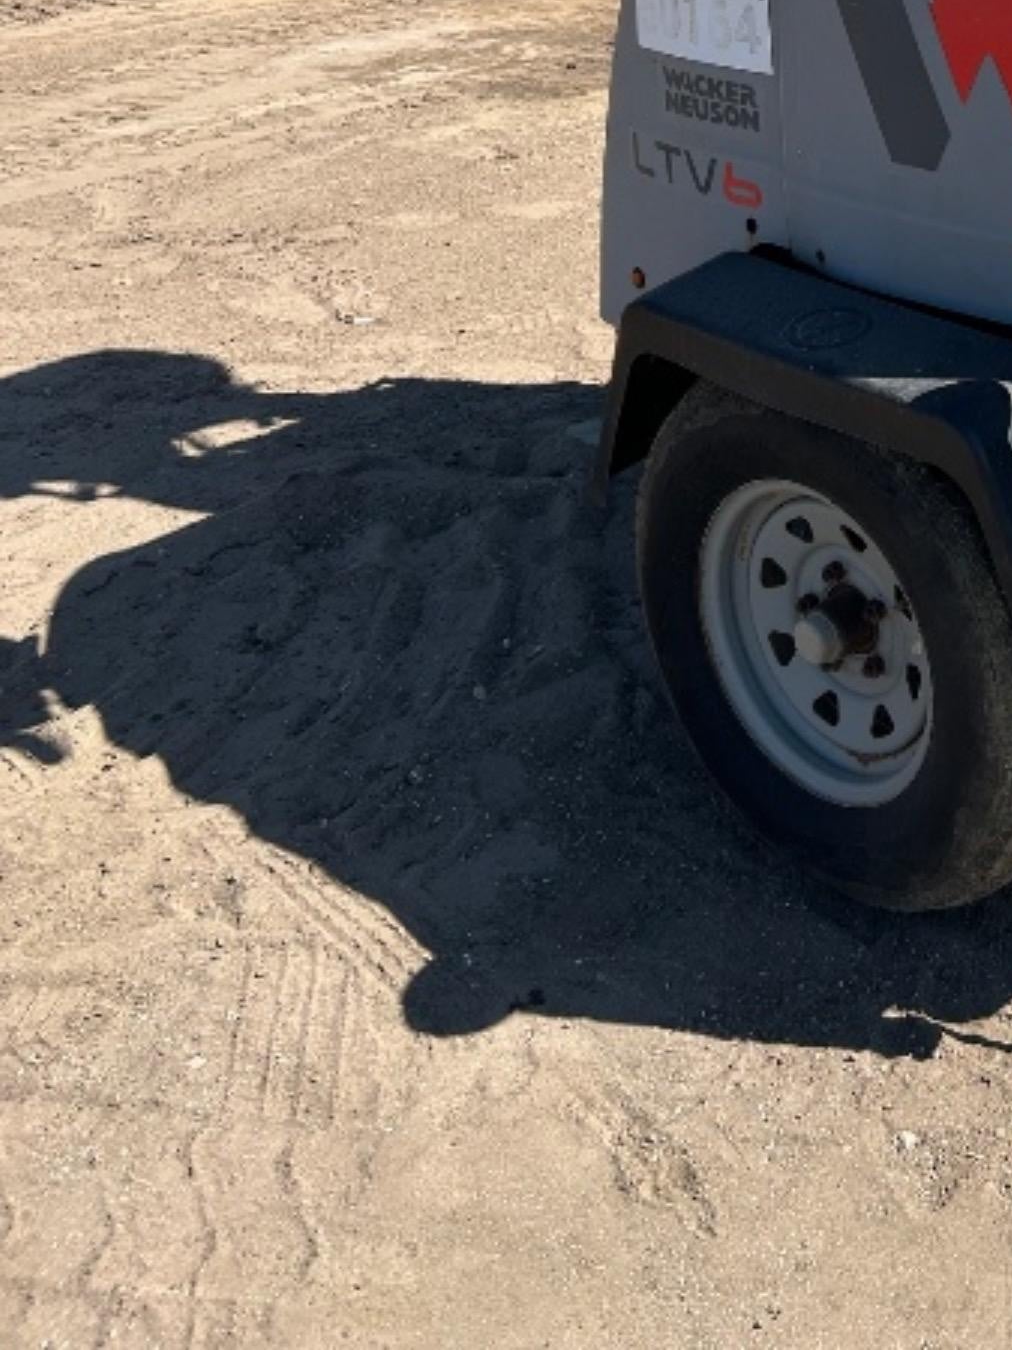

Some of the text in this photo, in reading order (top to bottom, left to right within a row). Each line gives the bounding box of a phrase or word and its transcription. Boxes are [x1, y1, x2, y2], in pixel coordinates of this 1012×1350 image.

[662, 66, 758, 109] WACKER
[665, 89, 760, 133] NEUSON
[631, 131, 764, 210] LTV6
